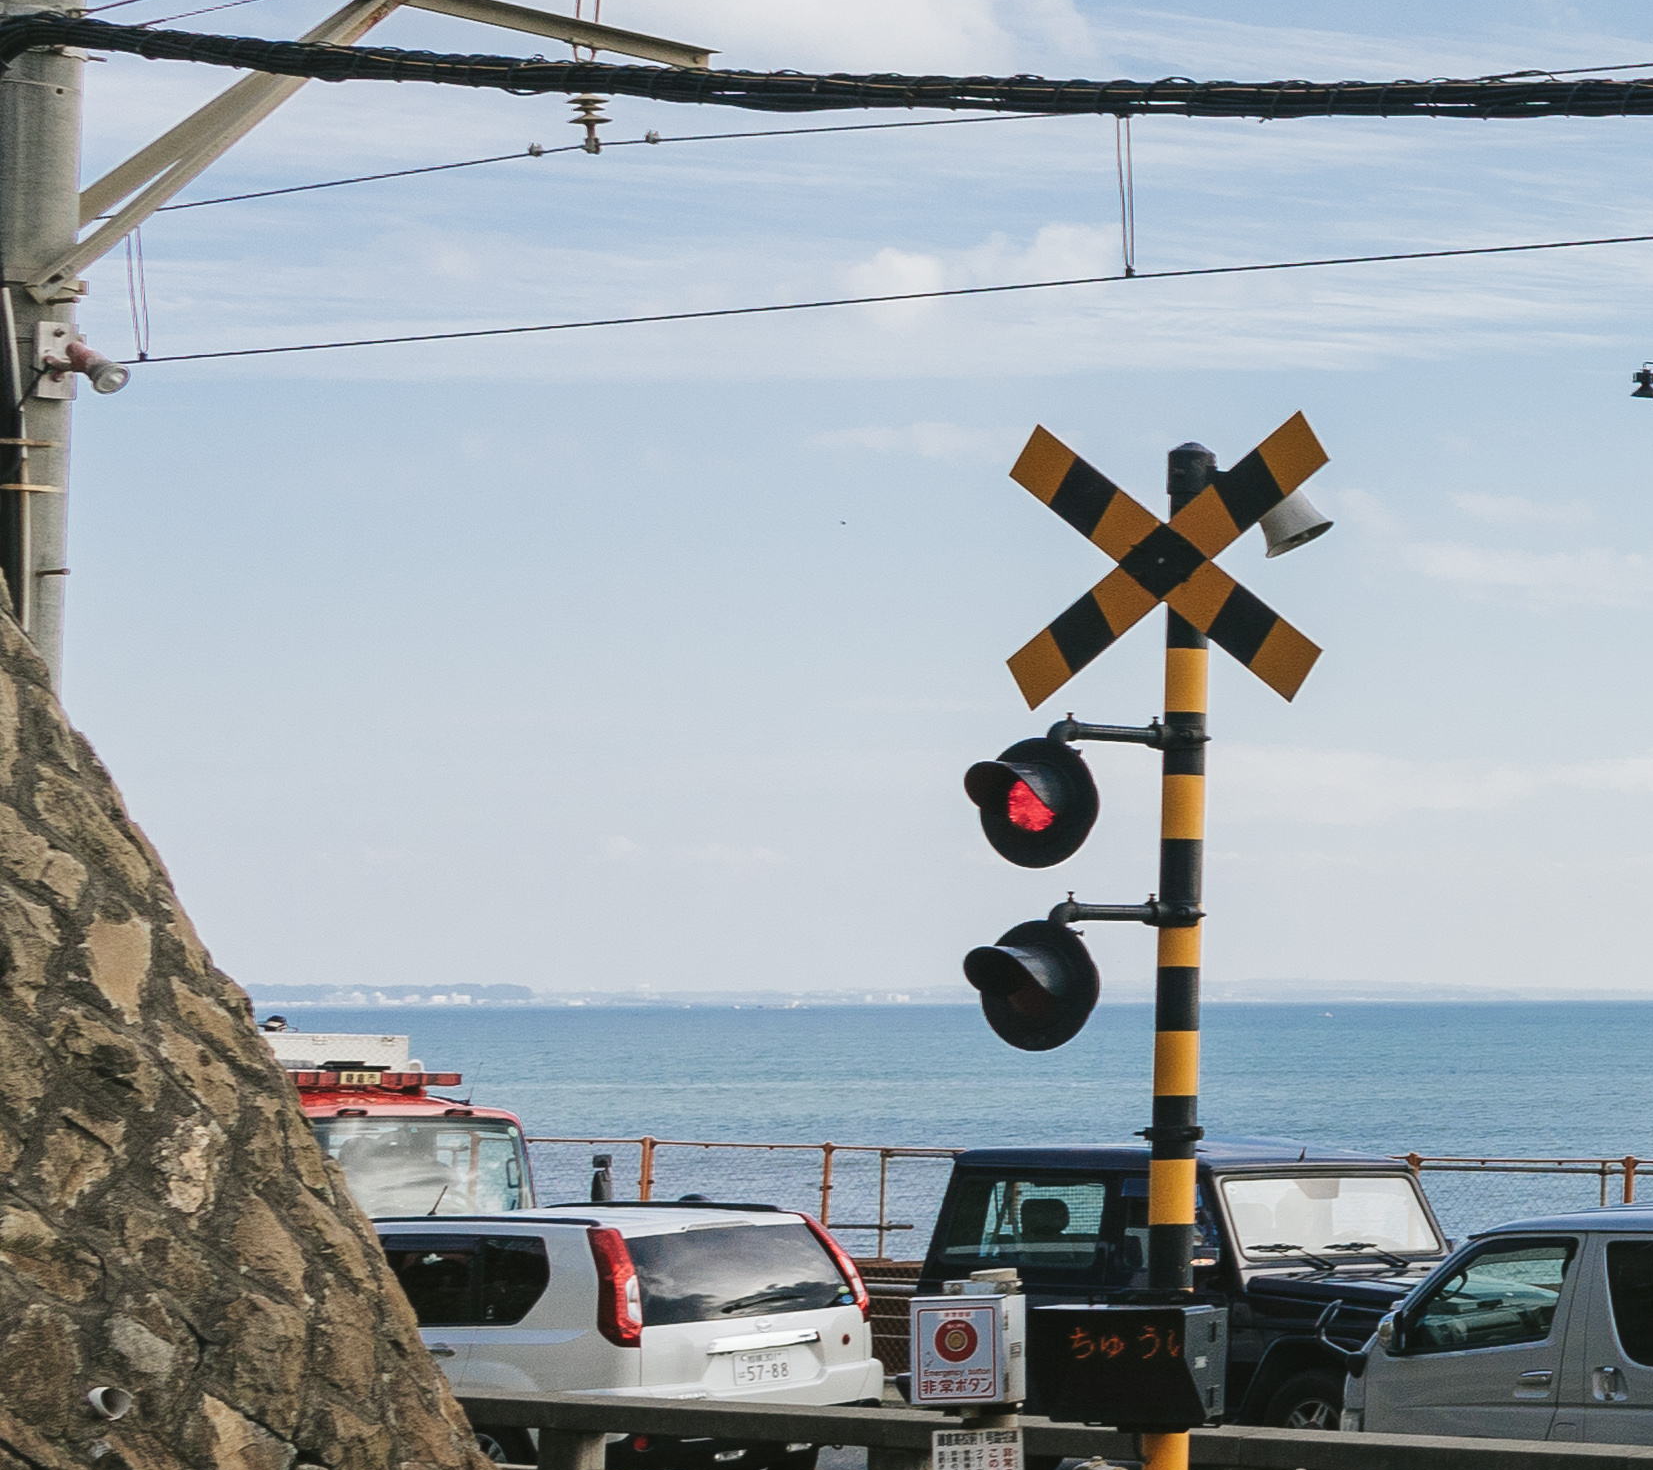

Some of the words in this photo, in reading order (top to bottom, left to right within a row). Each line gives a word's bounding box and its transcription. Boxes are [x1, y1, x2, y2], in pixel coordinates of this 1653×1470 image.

[747, 1362, 789, 1381] 57-88
[923, 1369, 965, 1378] Emergency
[922, 1377, 993, 1395] 非常ボタン
